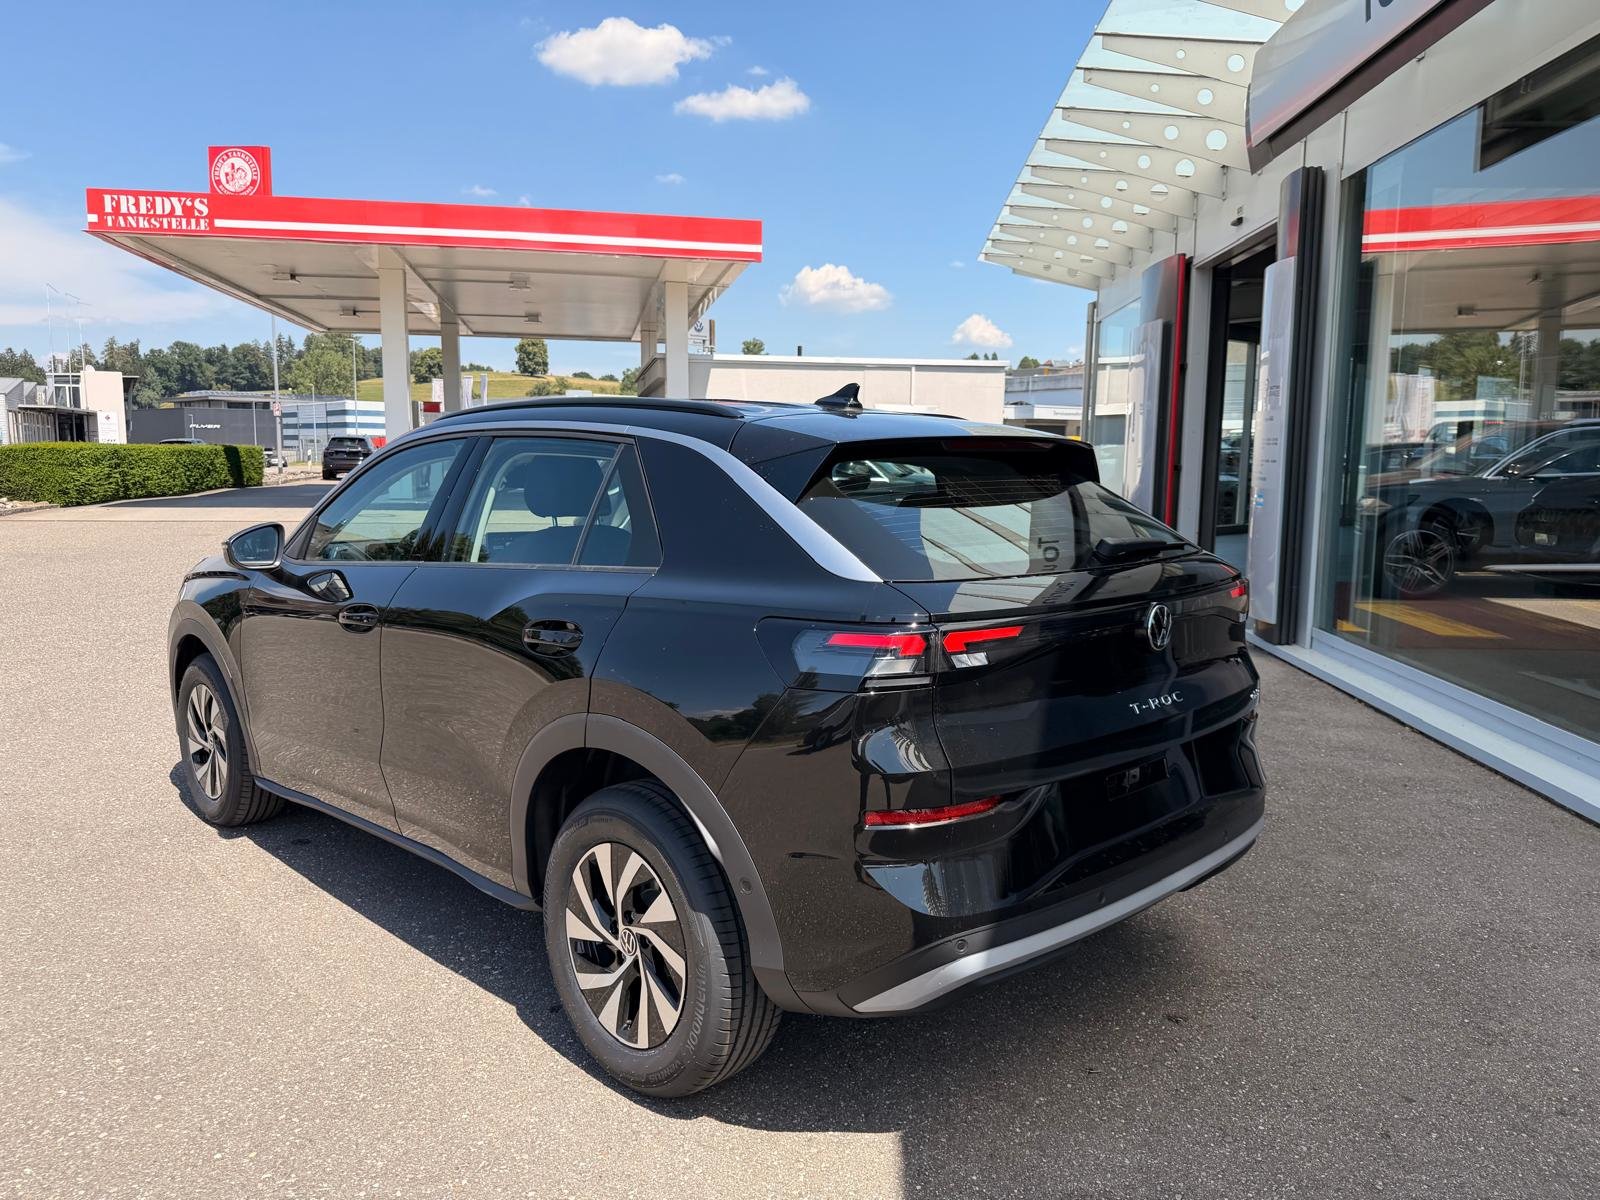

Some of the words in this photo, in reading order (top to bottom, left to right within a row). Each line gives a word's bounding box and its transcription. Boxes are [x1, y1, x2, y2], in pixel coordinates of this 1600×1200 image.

[103, 193, 209, 217] FREDY'S
[104, 215, 210, 231] TANKSTELLE
[1129, 691, 1184, 715] T-ROC
